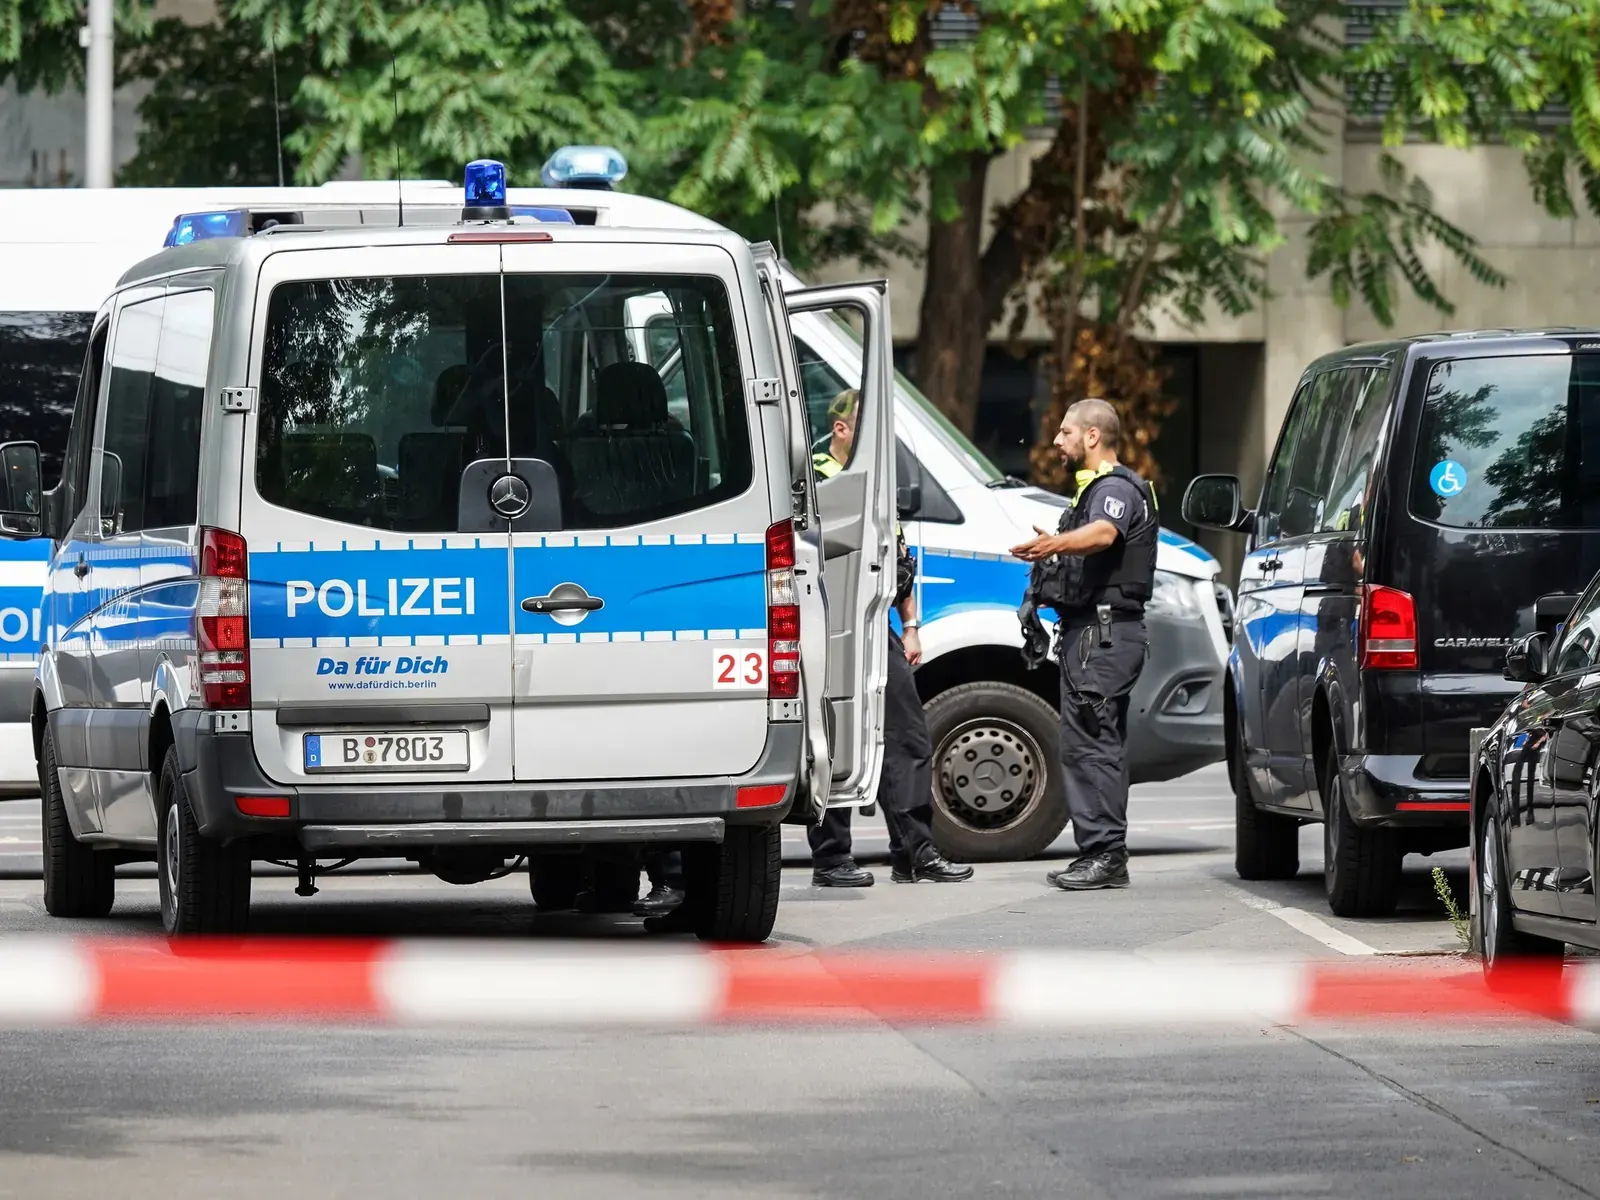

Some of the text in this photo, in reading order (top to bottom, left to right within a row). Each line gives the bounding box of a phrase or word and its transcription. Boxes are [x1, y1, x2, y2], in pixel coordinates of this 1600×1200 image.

[286, 577, 475, 618] POLIZEI
[316, 656, 449, 675] Da für Dich
[717, 652, 763, 685] 23
[328, 680, 437, 690] www.dafürdich.berlin
[343, 736, 444, 763] B 7803
